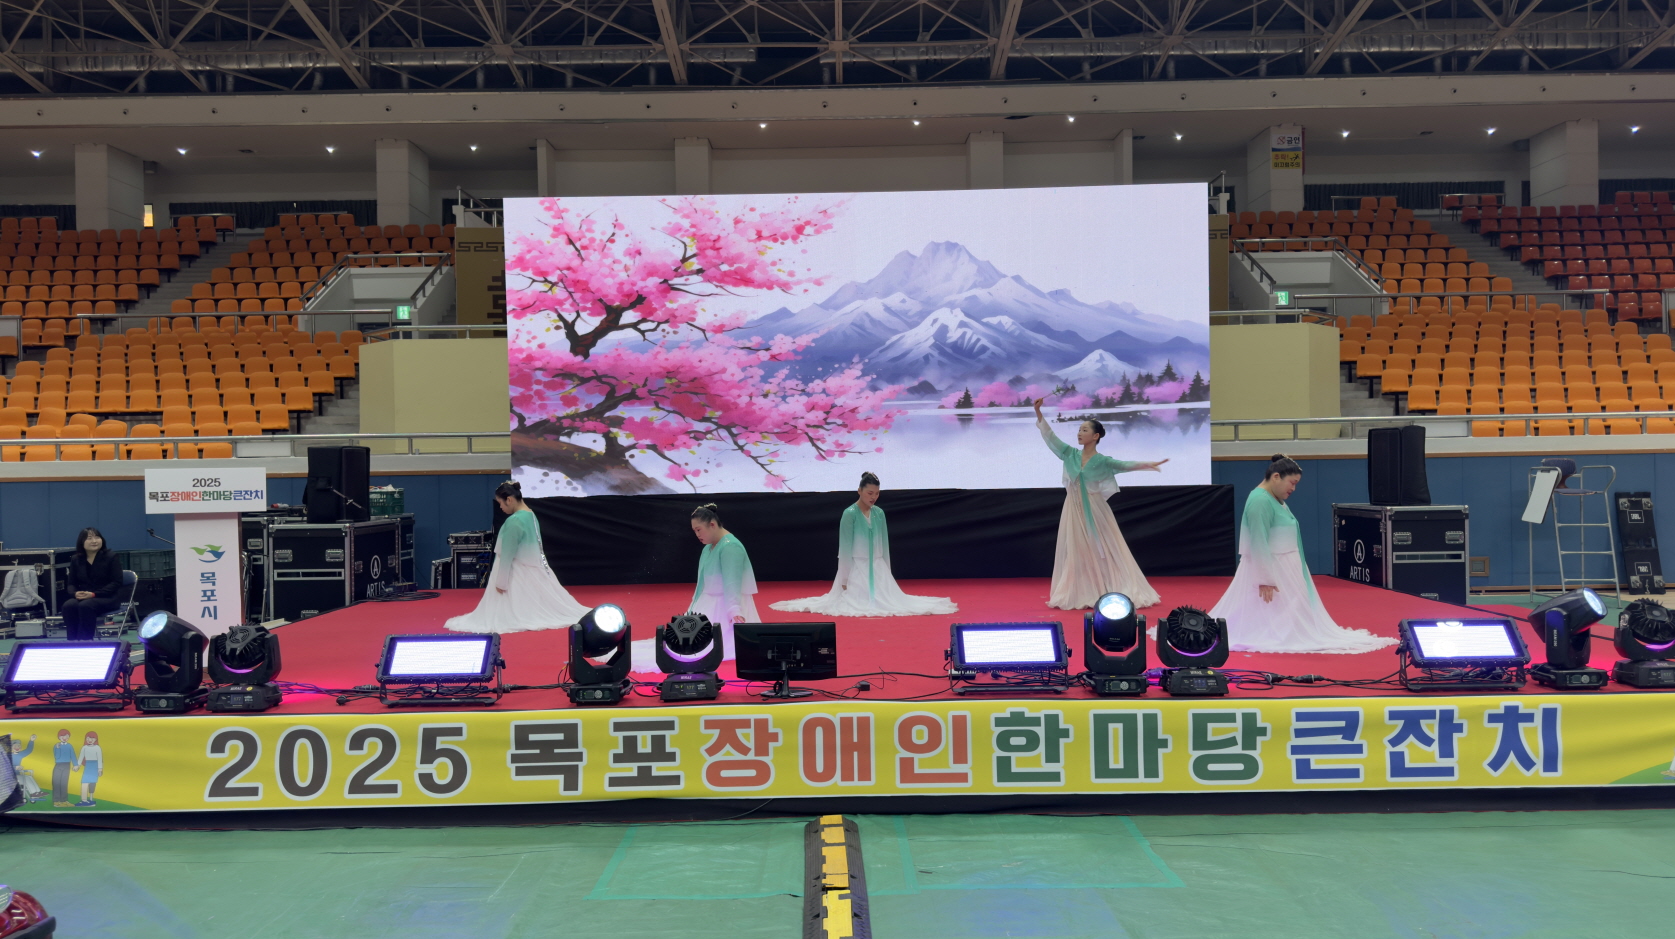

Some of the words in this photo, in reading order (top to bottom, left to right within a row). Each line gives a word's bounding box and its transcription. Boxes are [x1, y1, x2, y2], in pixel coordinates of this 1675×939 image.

[148, 489, 264, 503] 목포장애인한마당큰잔치
[192, 477, 221, 488] 2025
[1349, 565, 1371, 583] ARTIS
[200, 571, 218, 620] 목포시
[205, 722, 471, 801] 2025
[507, 701, 1562, 796] 목포장애인한마당큰잔치
